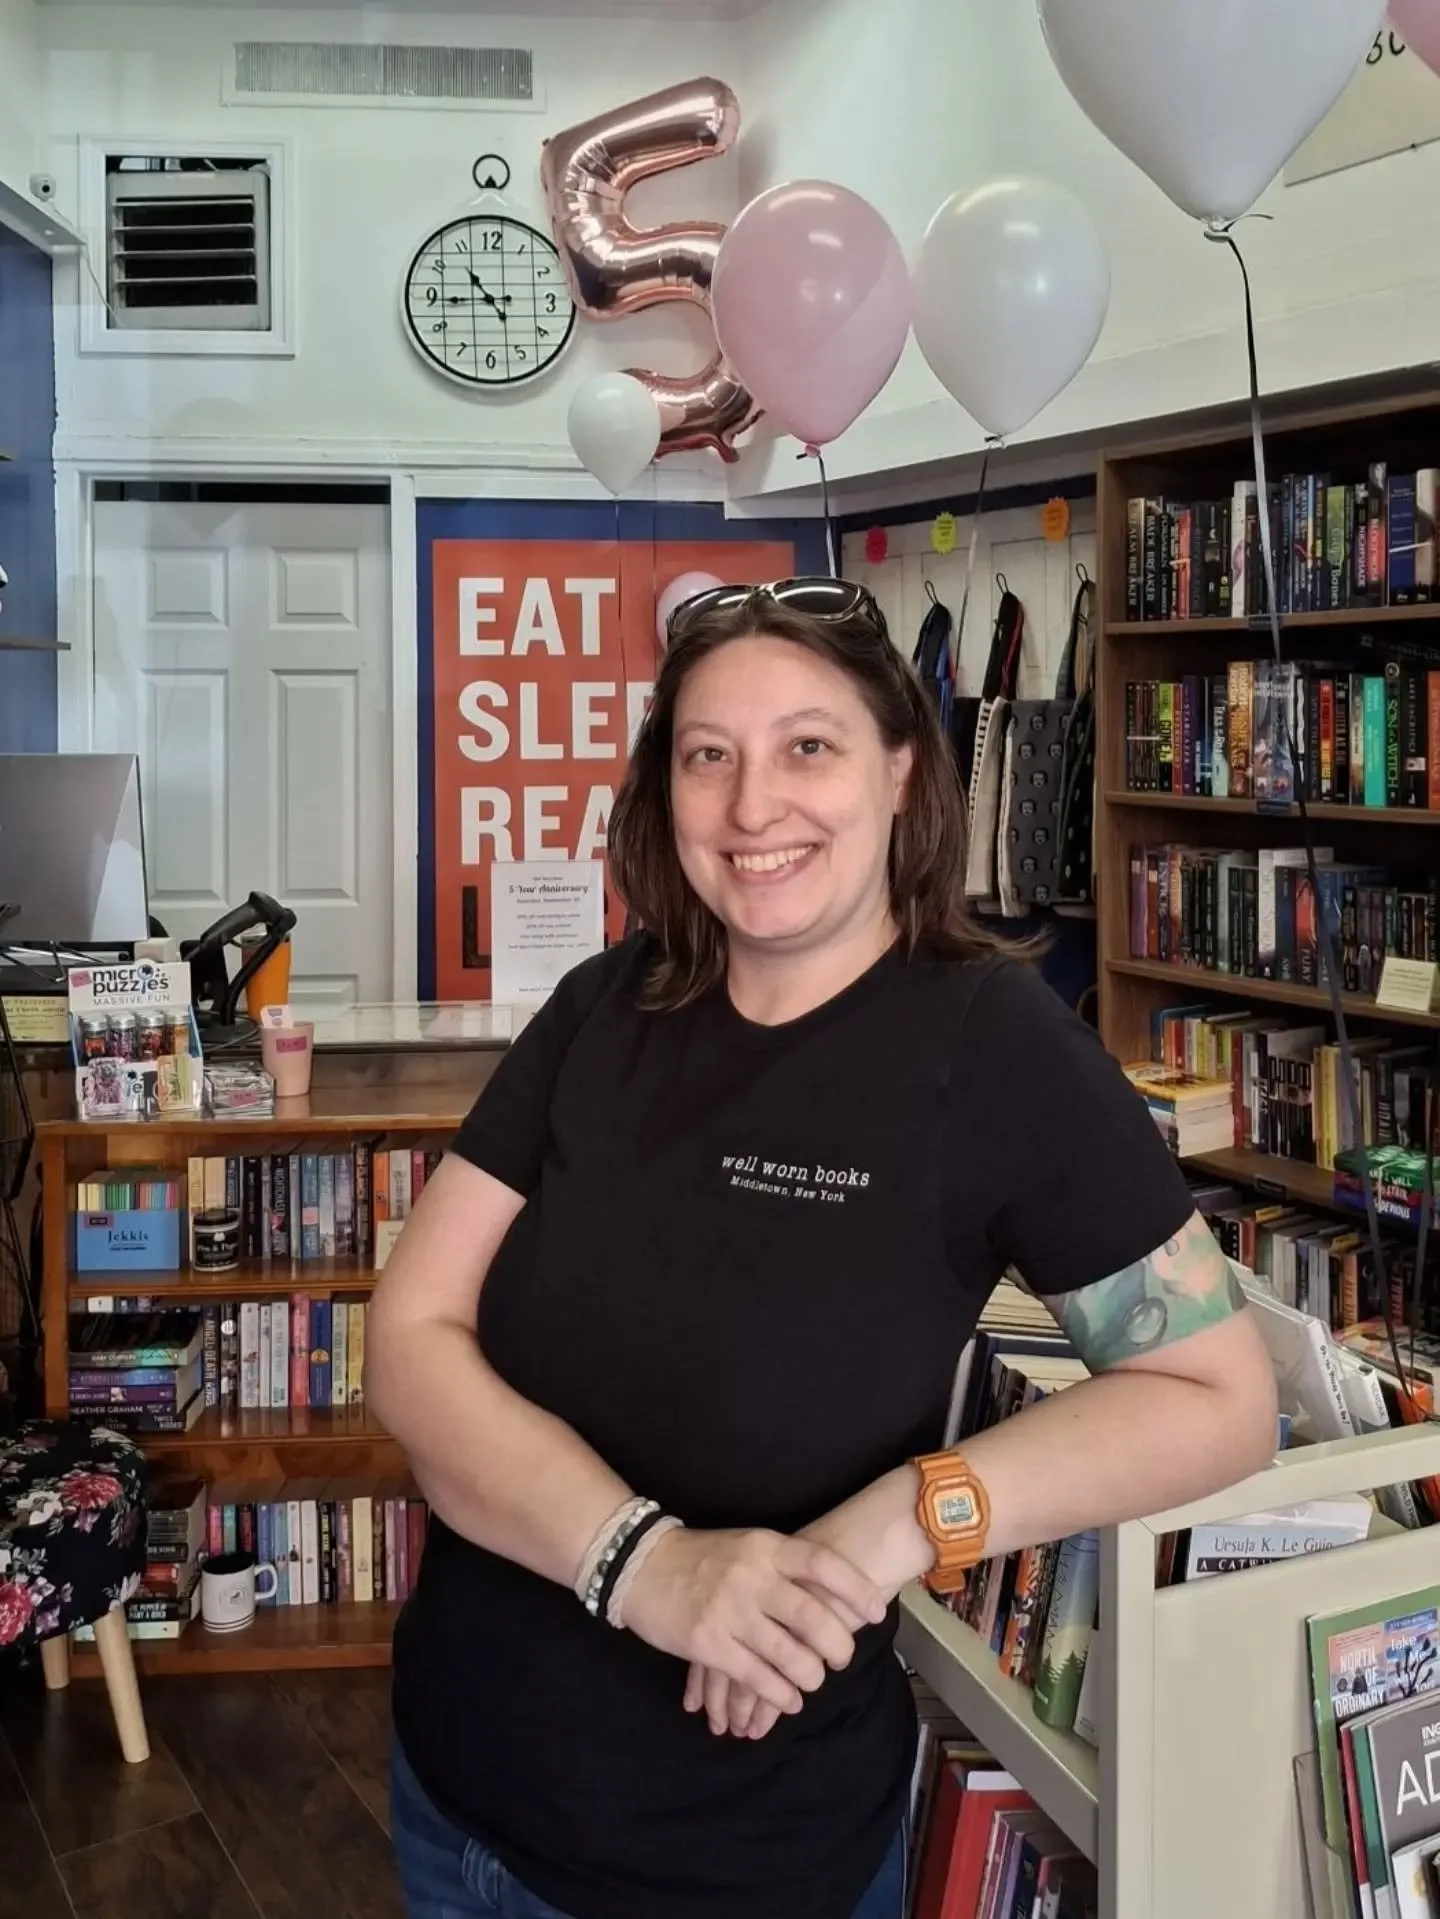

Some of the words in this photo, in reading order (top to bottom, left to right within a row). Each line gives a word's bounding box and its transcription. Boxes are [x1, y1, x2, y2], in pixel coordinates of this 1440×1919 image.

[455, 239, 468, 254] 11
[482, 231, 503, 251] 12
[432, 258, 447, 275] 10
[537, 266, 550, 279] 2
[426, 286, 438, 308] 9
[544, 292, 556, 313] 3
[432, 320, 448, 334] 8
[536, 325, 550, 339] 4
[456, 341, 468, 357] 7
[514, 344, 527, 361] 5
[485, 350, 497, 370] 6
[1146, 551, 1155, 602] BREAKER
[1331, 568, 1341, 607] Bones
[458, 577, 616, 656] EAT
[1387, 743, 1399, 789] WITCH
[93, 995, 143, 1006] MASSIVE
[148, 992, 170, 1002] FUN
[721, 1156, 758, 1172] well
[762, 1161, 808, 1181] worn
[815, 1165, 870, 1187] books
[730, 1175, 791, 1197] Middletown,
[794, 1187, 817, 1199] New
[820, 1189, 846, 1203] York
[205, 1350, 216, 1379] DEATH
[70, 1406, 106, 1415] HEATHER
[107, 1405, 143, 1414] GRAHAM
[1215, 1536, 1255, 1554] Ursula
[1261, 1537, 1275, 1552] K.
[1282, 1537, 1298, 1552] Le
[1303, 1536, 1333, 1552] Guin
[1199, 1559, 1208, 1570] A
[1218, 1558, 1273, 1570] CATW
[1391, 1635, 1417, 1651] Take
[1340, 1644, 1377, 1674] NORTH
[1365, 1667, 1377, 1687] OF
[1334, 1687, 1385, 1718] ORDINARY
